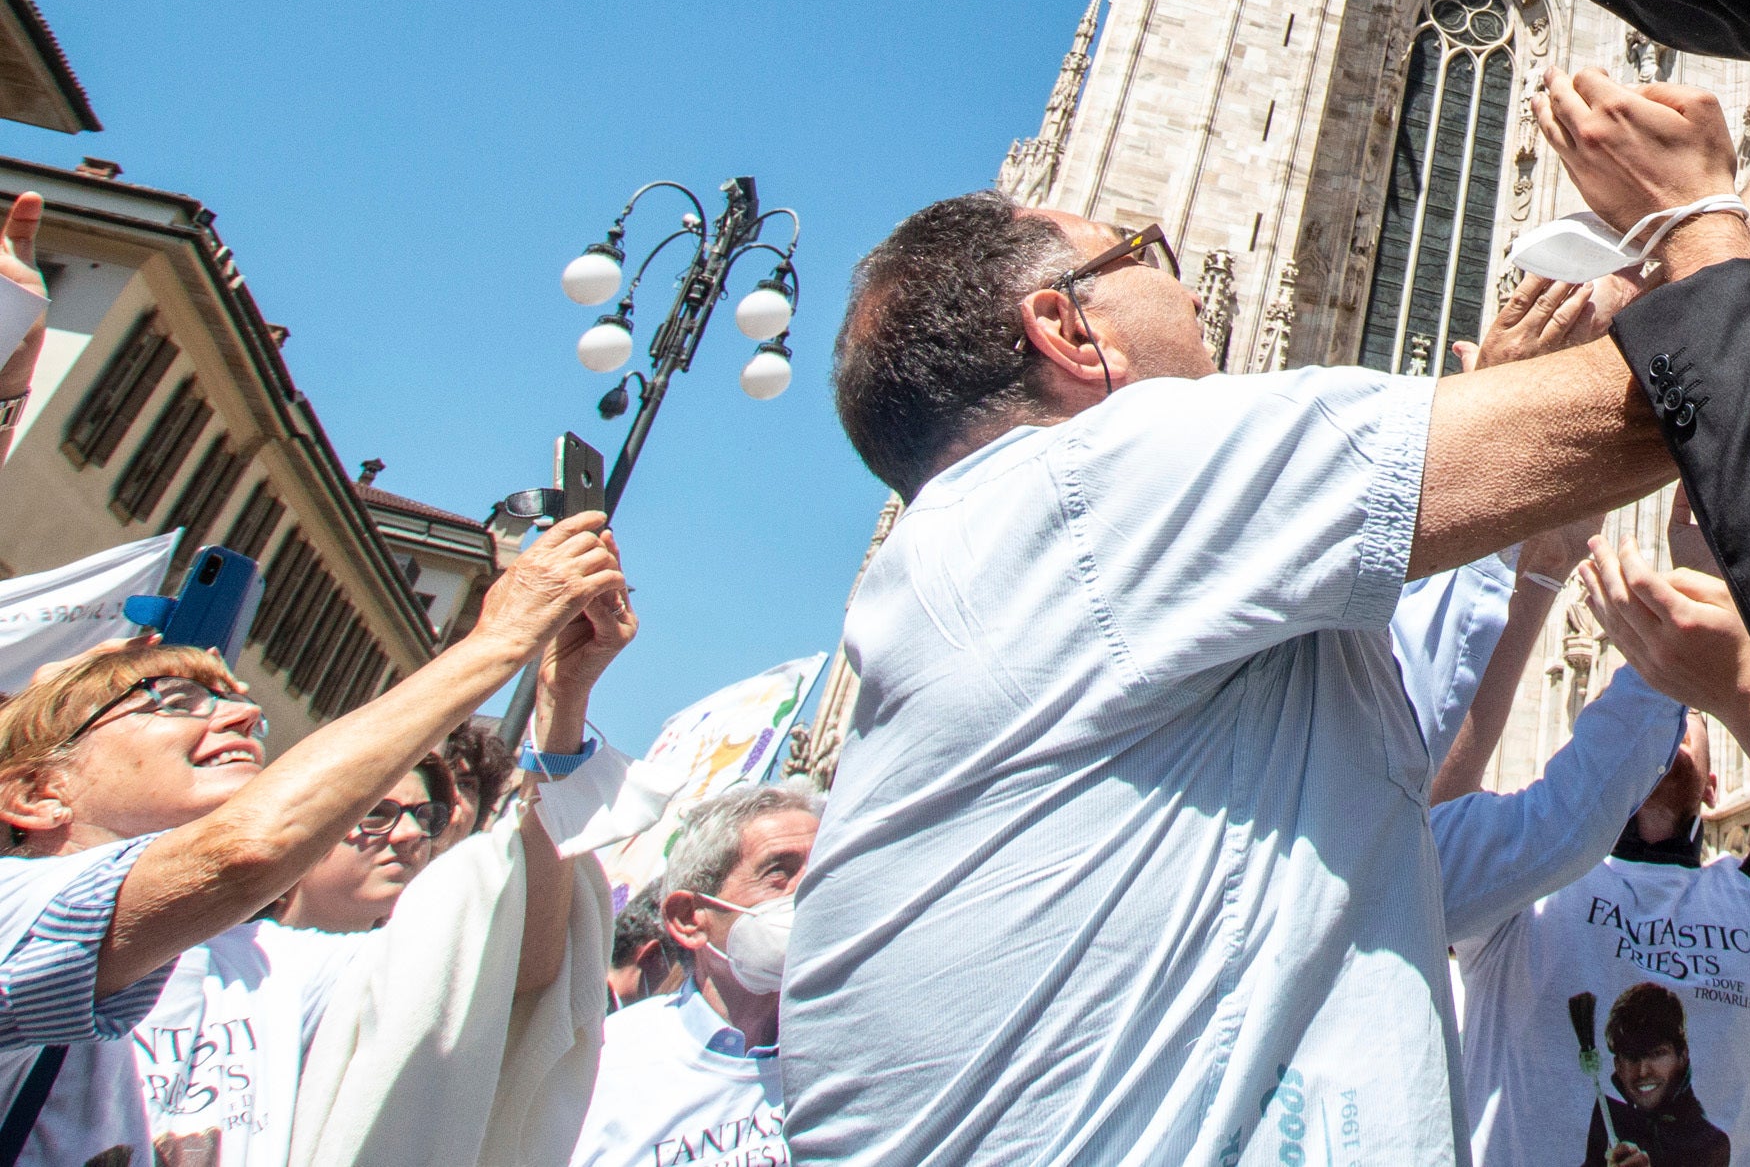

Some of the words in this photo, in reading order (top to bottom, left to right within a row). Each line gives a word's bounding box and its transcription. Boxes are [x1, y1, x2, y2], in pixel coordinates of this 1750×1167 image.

[1586, 896, 1750, 954] FANTASTIC
[1615, 936, 1721, 980] PRIESTS
[1711, 977, 1745, 993] DOVE
[1340, 1087, 1361, 1150] 1994
